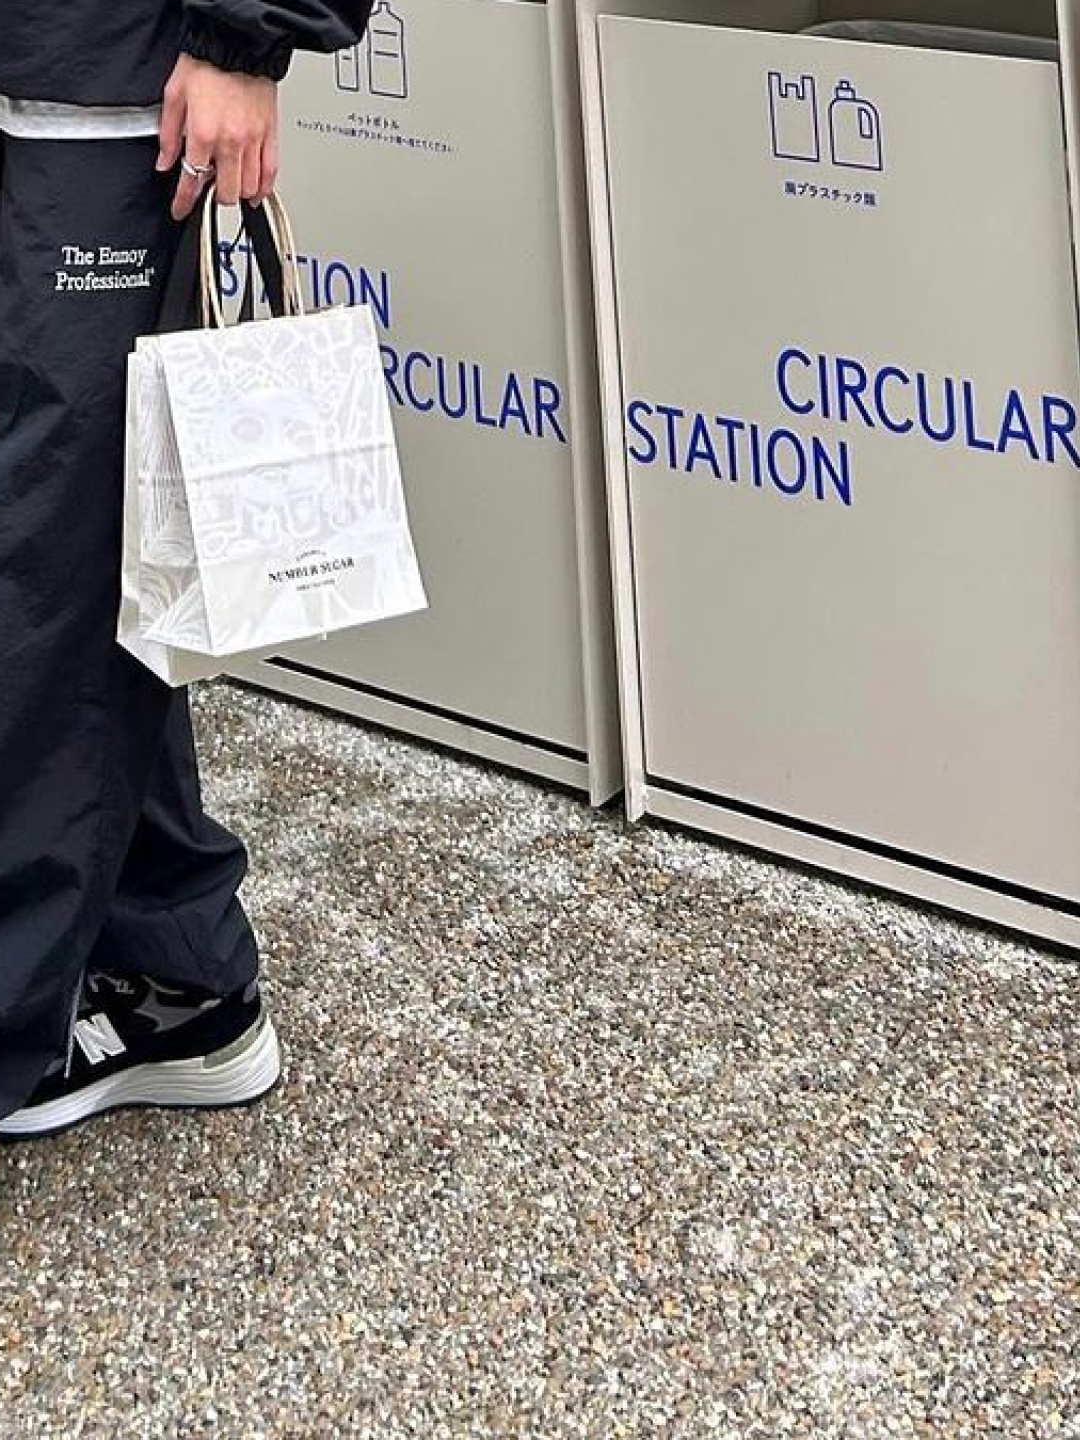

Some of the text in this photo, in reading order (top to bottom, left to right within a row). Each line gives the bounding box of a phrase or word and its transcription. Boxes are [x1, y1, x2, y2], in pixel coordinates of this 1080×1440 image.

[62, 246, 148, 267] The Ennoy
[627, 400, 851, 506] STATION
[777, 348, 1080, 469] CIRCULAR
